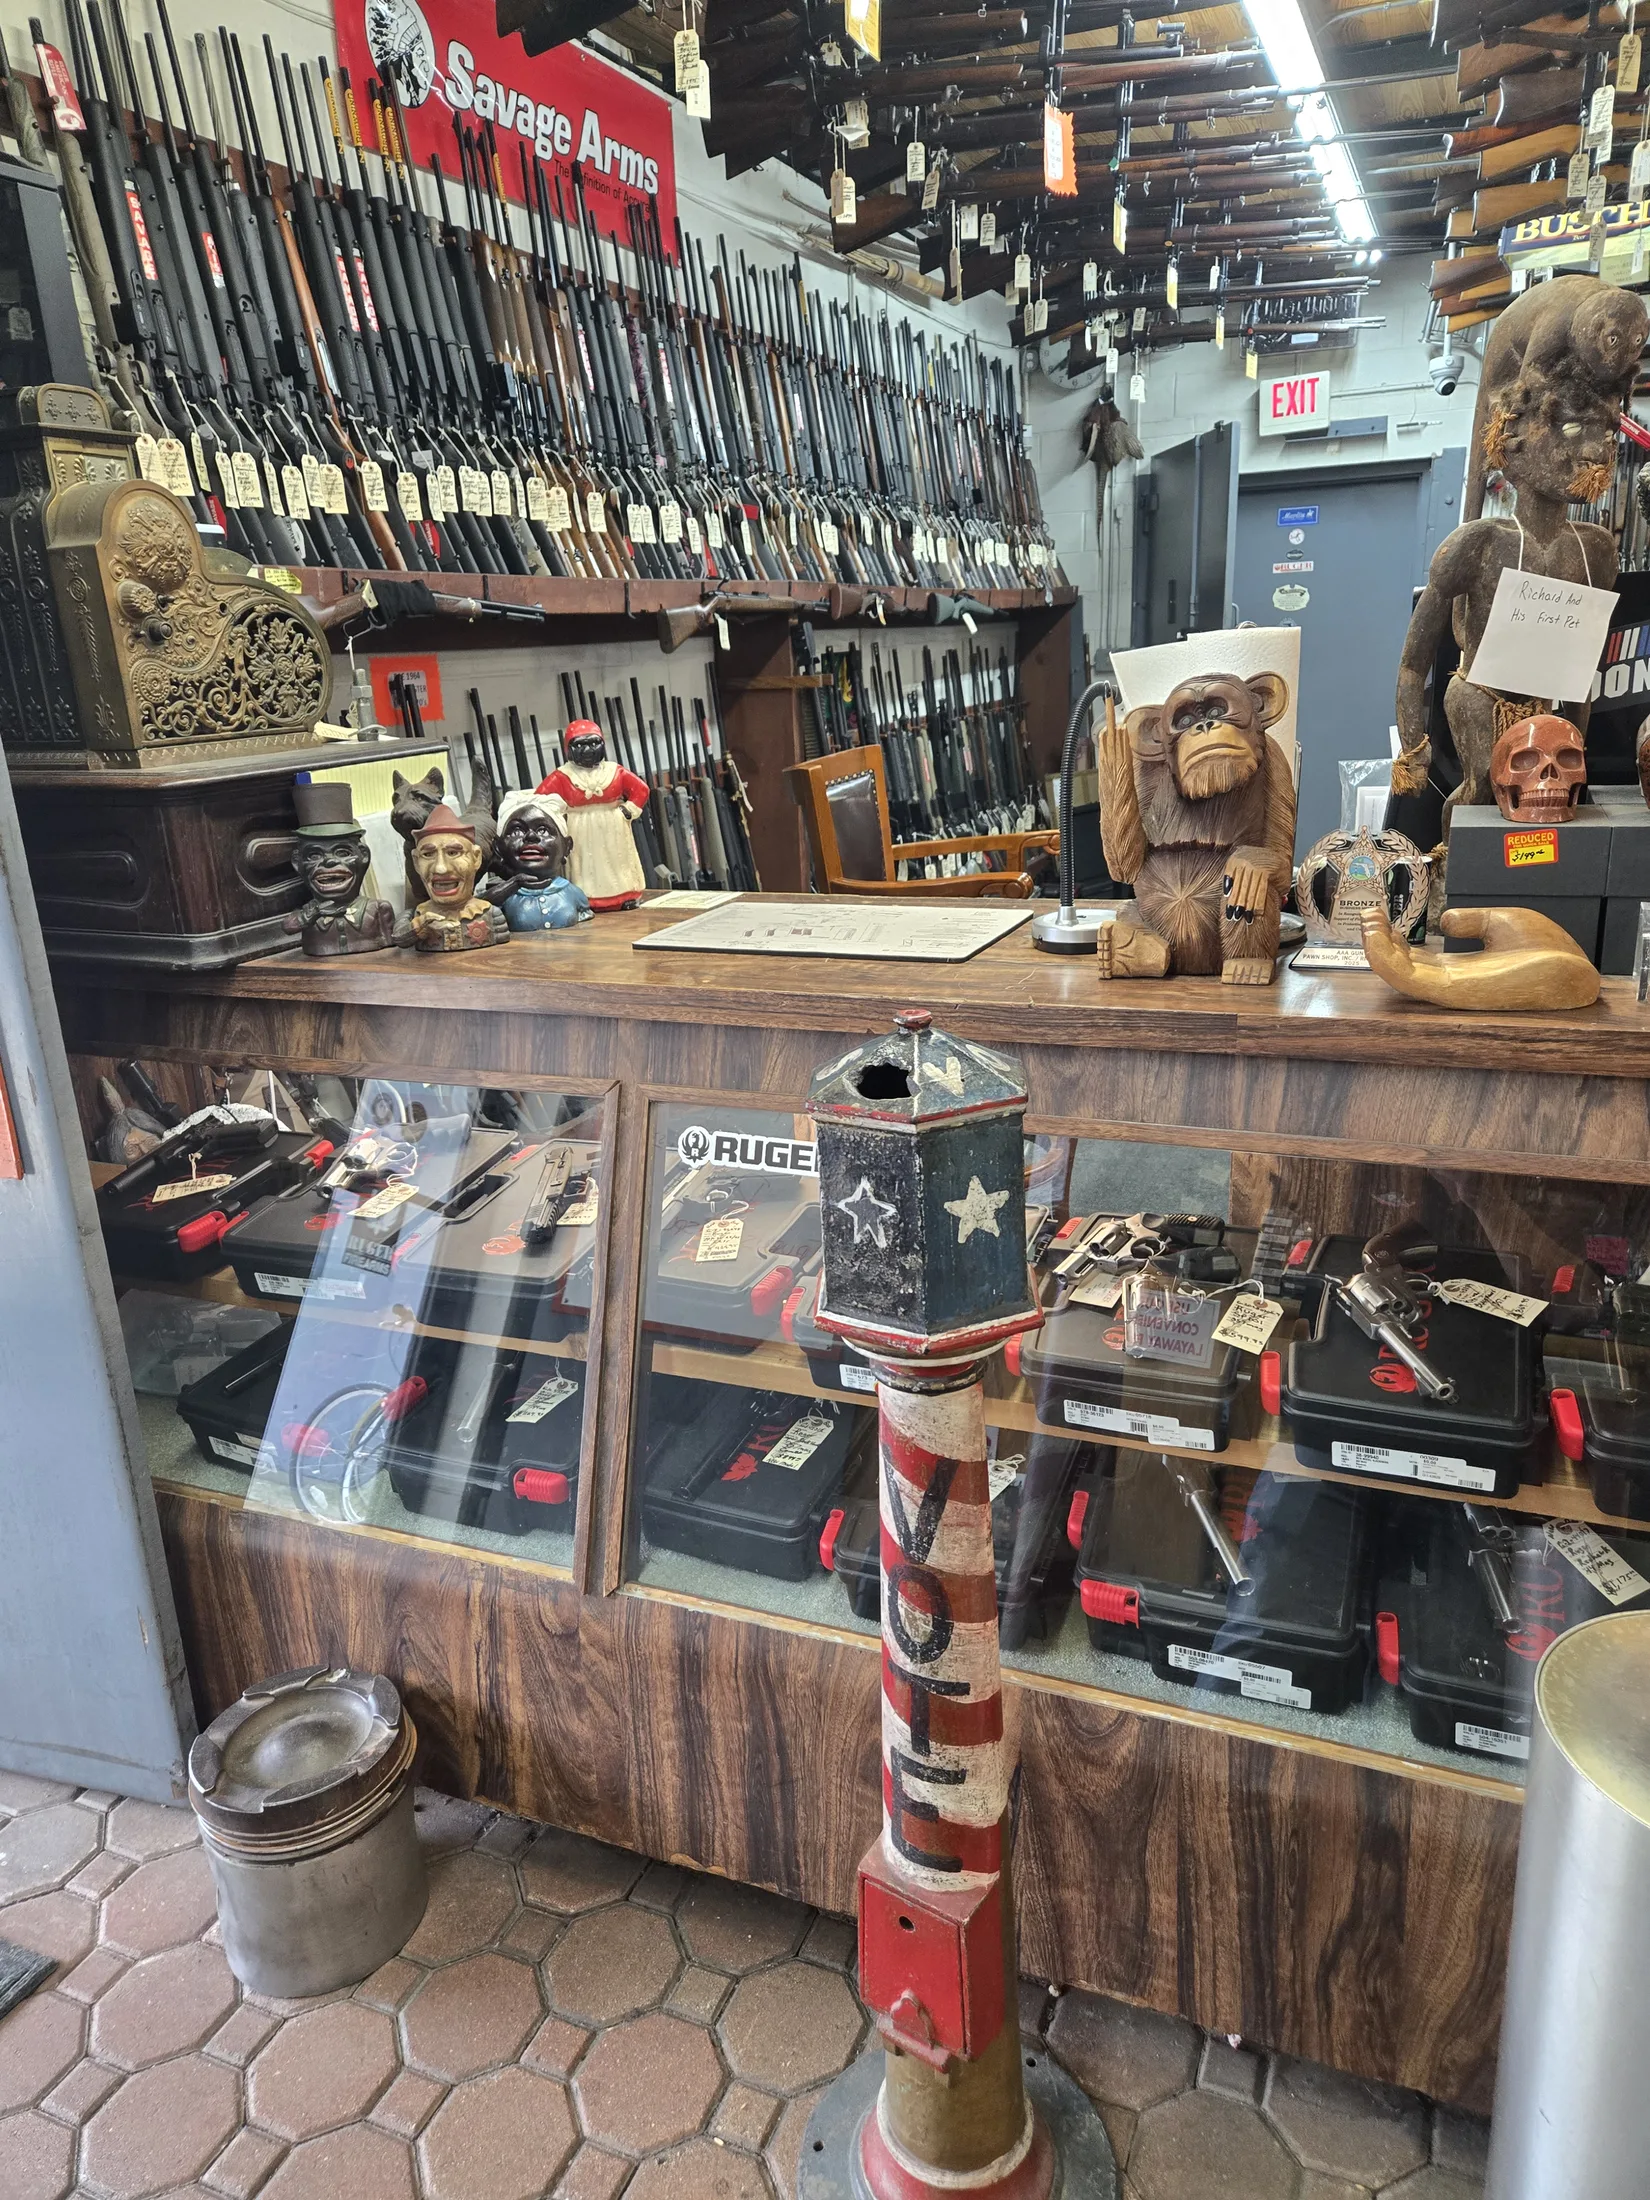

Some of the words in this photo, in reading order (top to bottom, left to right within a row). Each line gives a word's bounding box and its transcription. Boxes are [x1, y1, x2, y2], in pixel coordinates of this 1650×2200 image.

[445, 40, 572, 161] Savage
[576, 107, 660, 195] Arms
[555, 159, 570, 178] The
[613, 187, 622, 199] of
[129, 196, 158, 280] SAVAGE
[1511, 199, 1650, 243] BUSCH
[1272, 377, 1320, 418] EXIT
[1518, 580, 1564, 603] Richard
[1565, 593, 1583, 606] And
[1510, 607, 1526, 622] His
[1536, 611, 1560, 624] First
[1563, 615, 1581, 629] Pet
[1507, 832, 1555, 845] REDUCED
[714, 1135, 820, 1173] RUGE
[880, 1442, 971, 1873] VOTE
